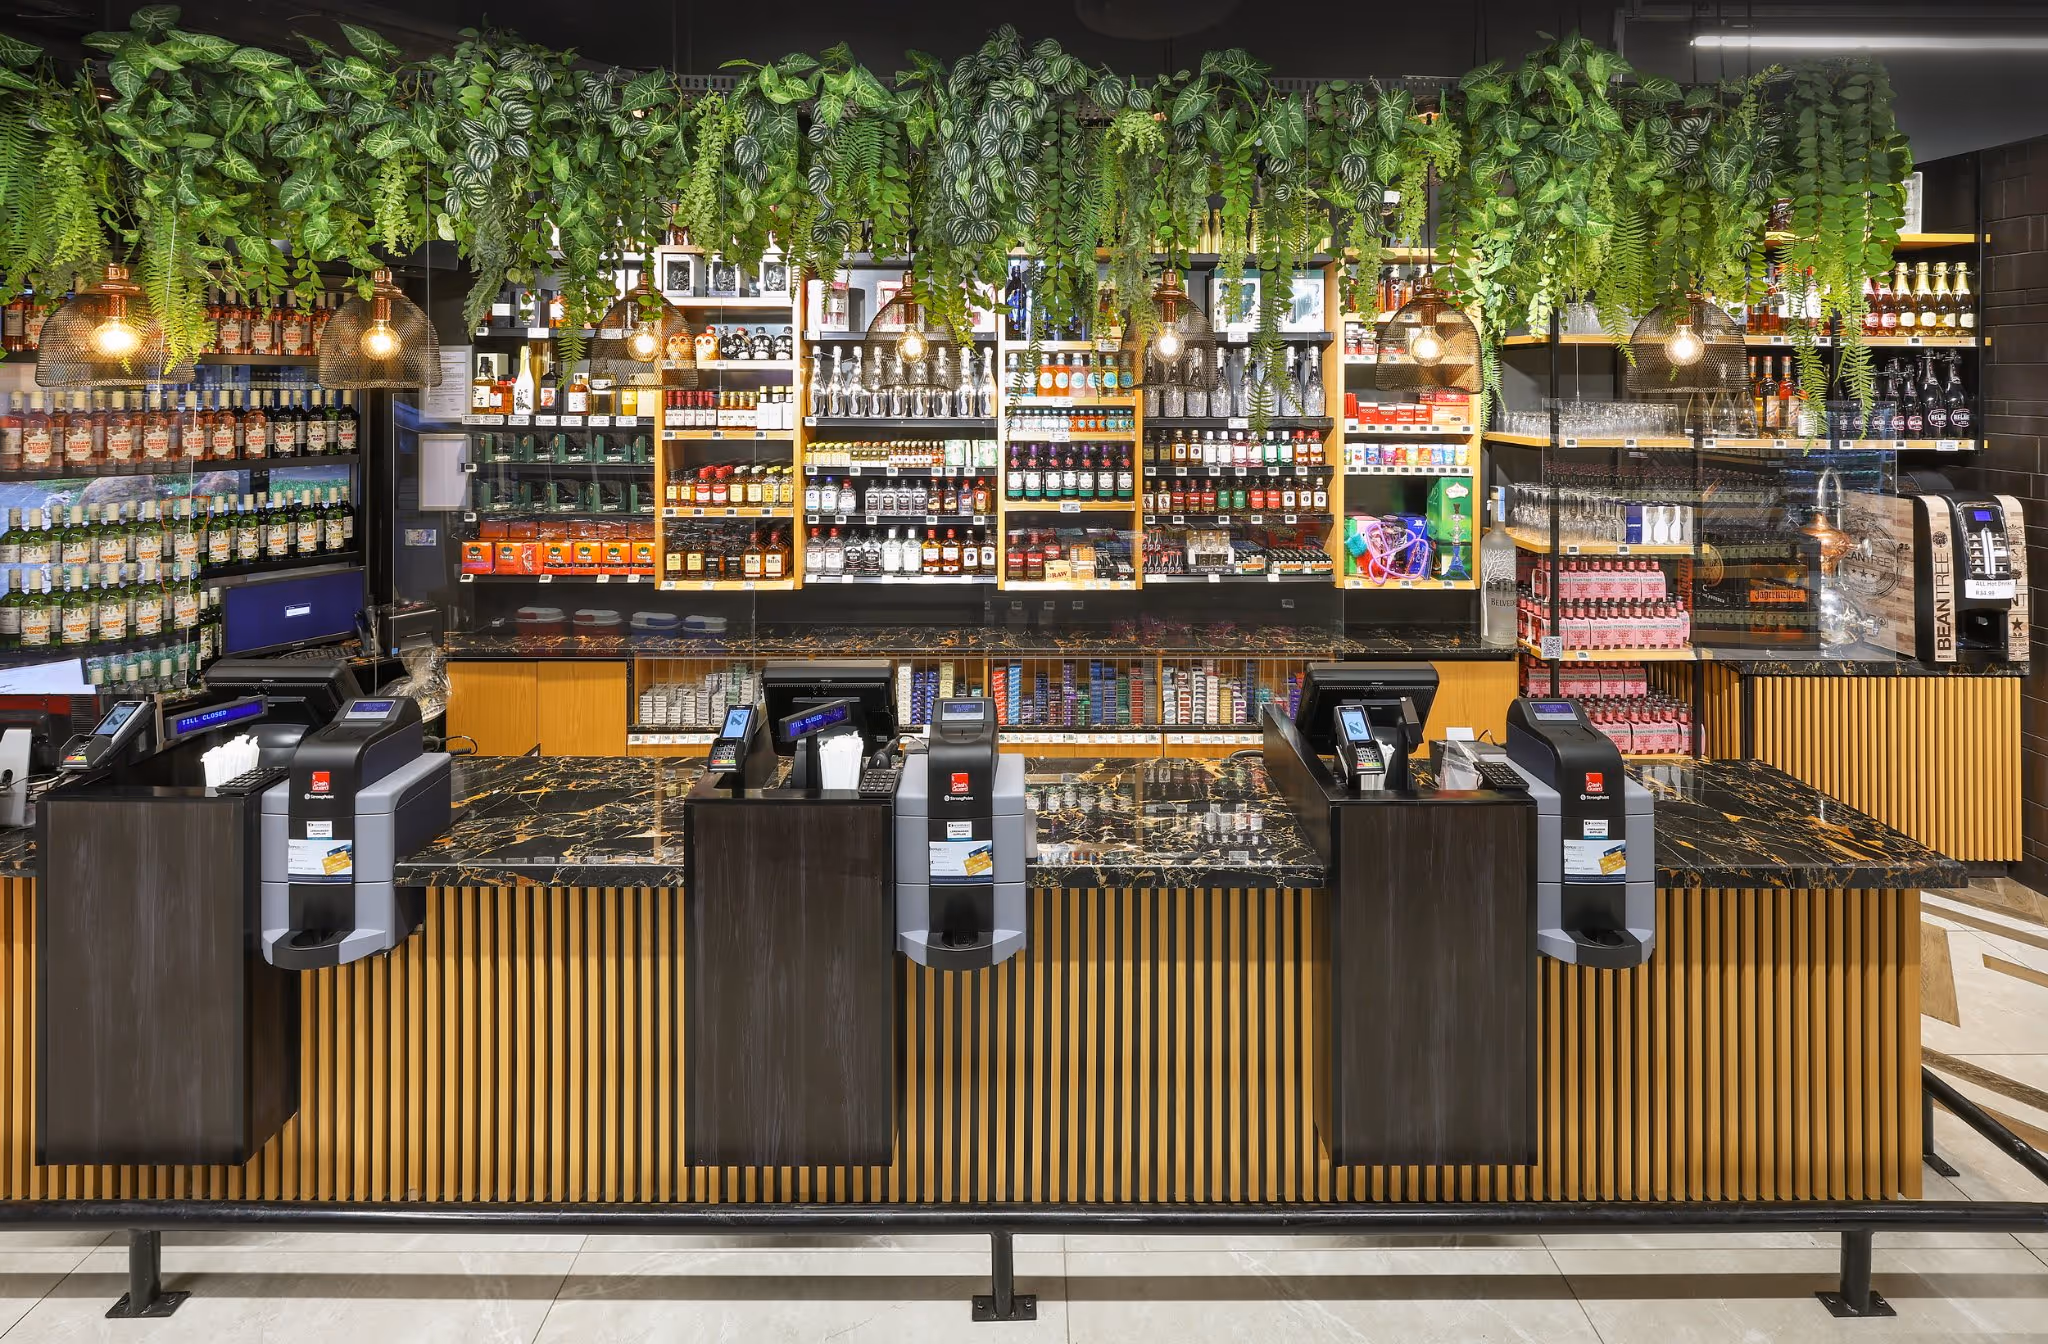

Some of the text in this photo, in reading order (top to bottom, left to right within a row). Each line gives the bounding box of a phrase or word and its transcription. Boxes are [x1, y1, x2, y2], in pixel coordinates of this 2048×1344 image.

[1934, 552, 1951, 651] BEANTREE
[202, 710, 226, 720] CLOSED
[806, 715, 822, 723] CLOSED
